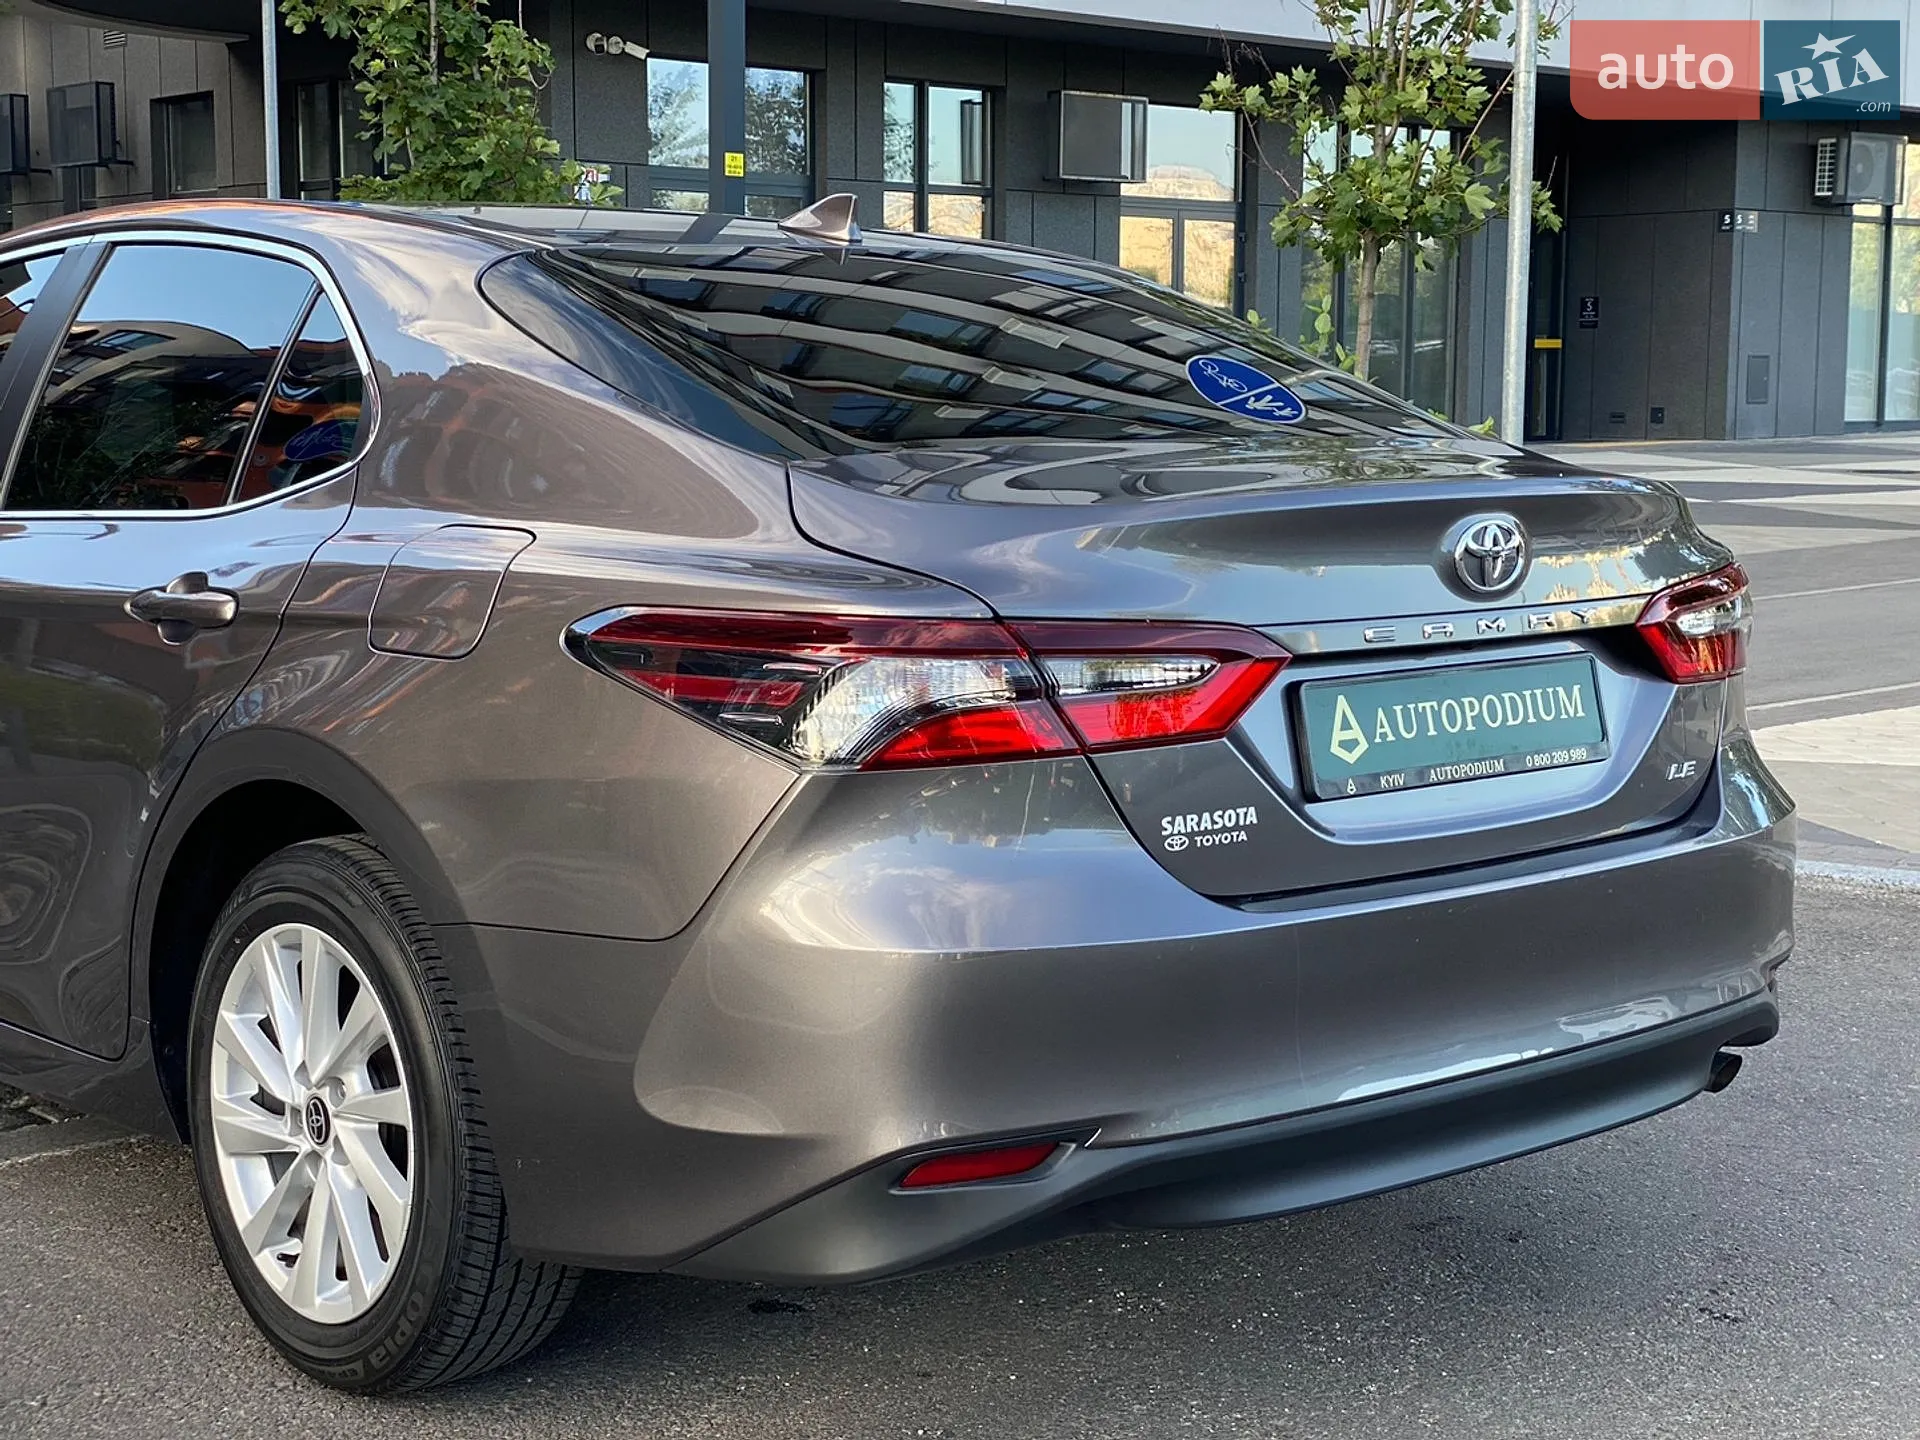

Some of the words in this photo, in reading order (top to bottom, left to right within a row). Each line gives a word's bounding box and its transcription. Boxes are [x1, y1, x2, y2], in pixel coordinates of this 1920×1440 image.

[1363, 607, 1596, 643] CAMRY
[1374, 684, 1585, 743] AUTOPODIUM
[1379, 773, 1405, 788] KYIV
[1429, 759, 1505, 782] AUTOPODIUM
[1526, 754, 1533, 767] 0
[1533, 752, 1551, 766] 800
[1551, 750, 1569, 764] 209
[1666, 760, 1696, 780] LE
[1161, 806, 1258, 836] SARASOTA
[1194, 830, 1248, 847] TOYOTA
